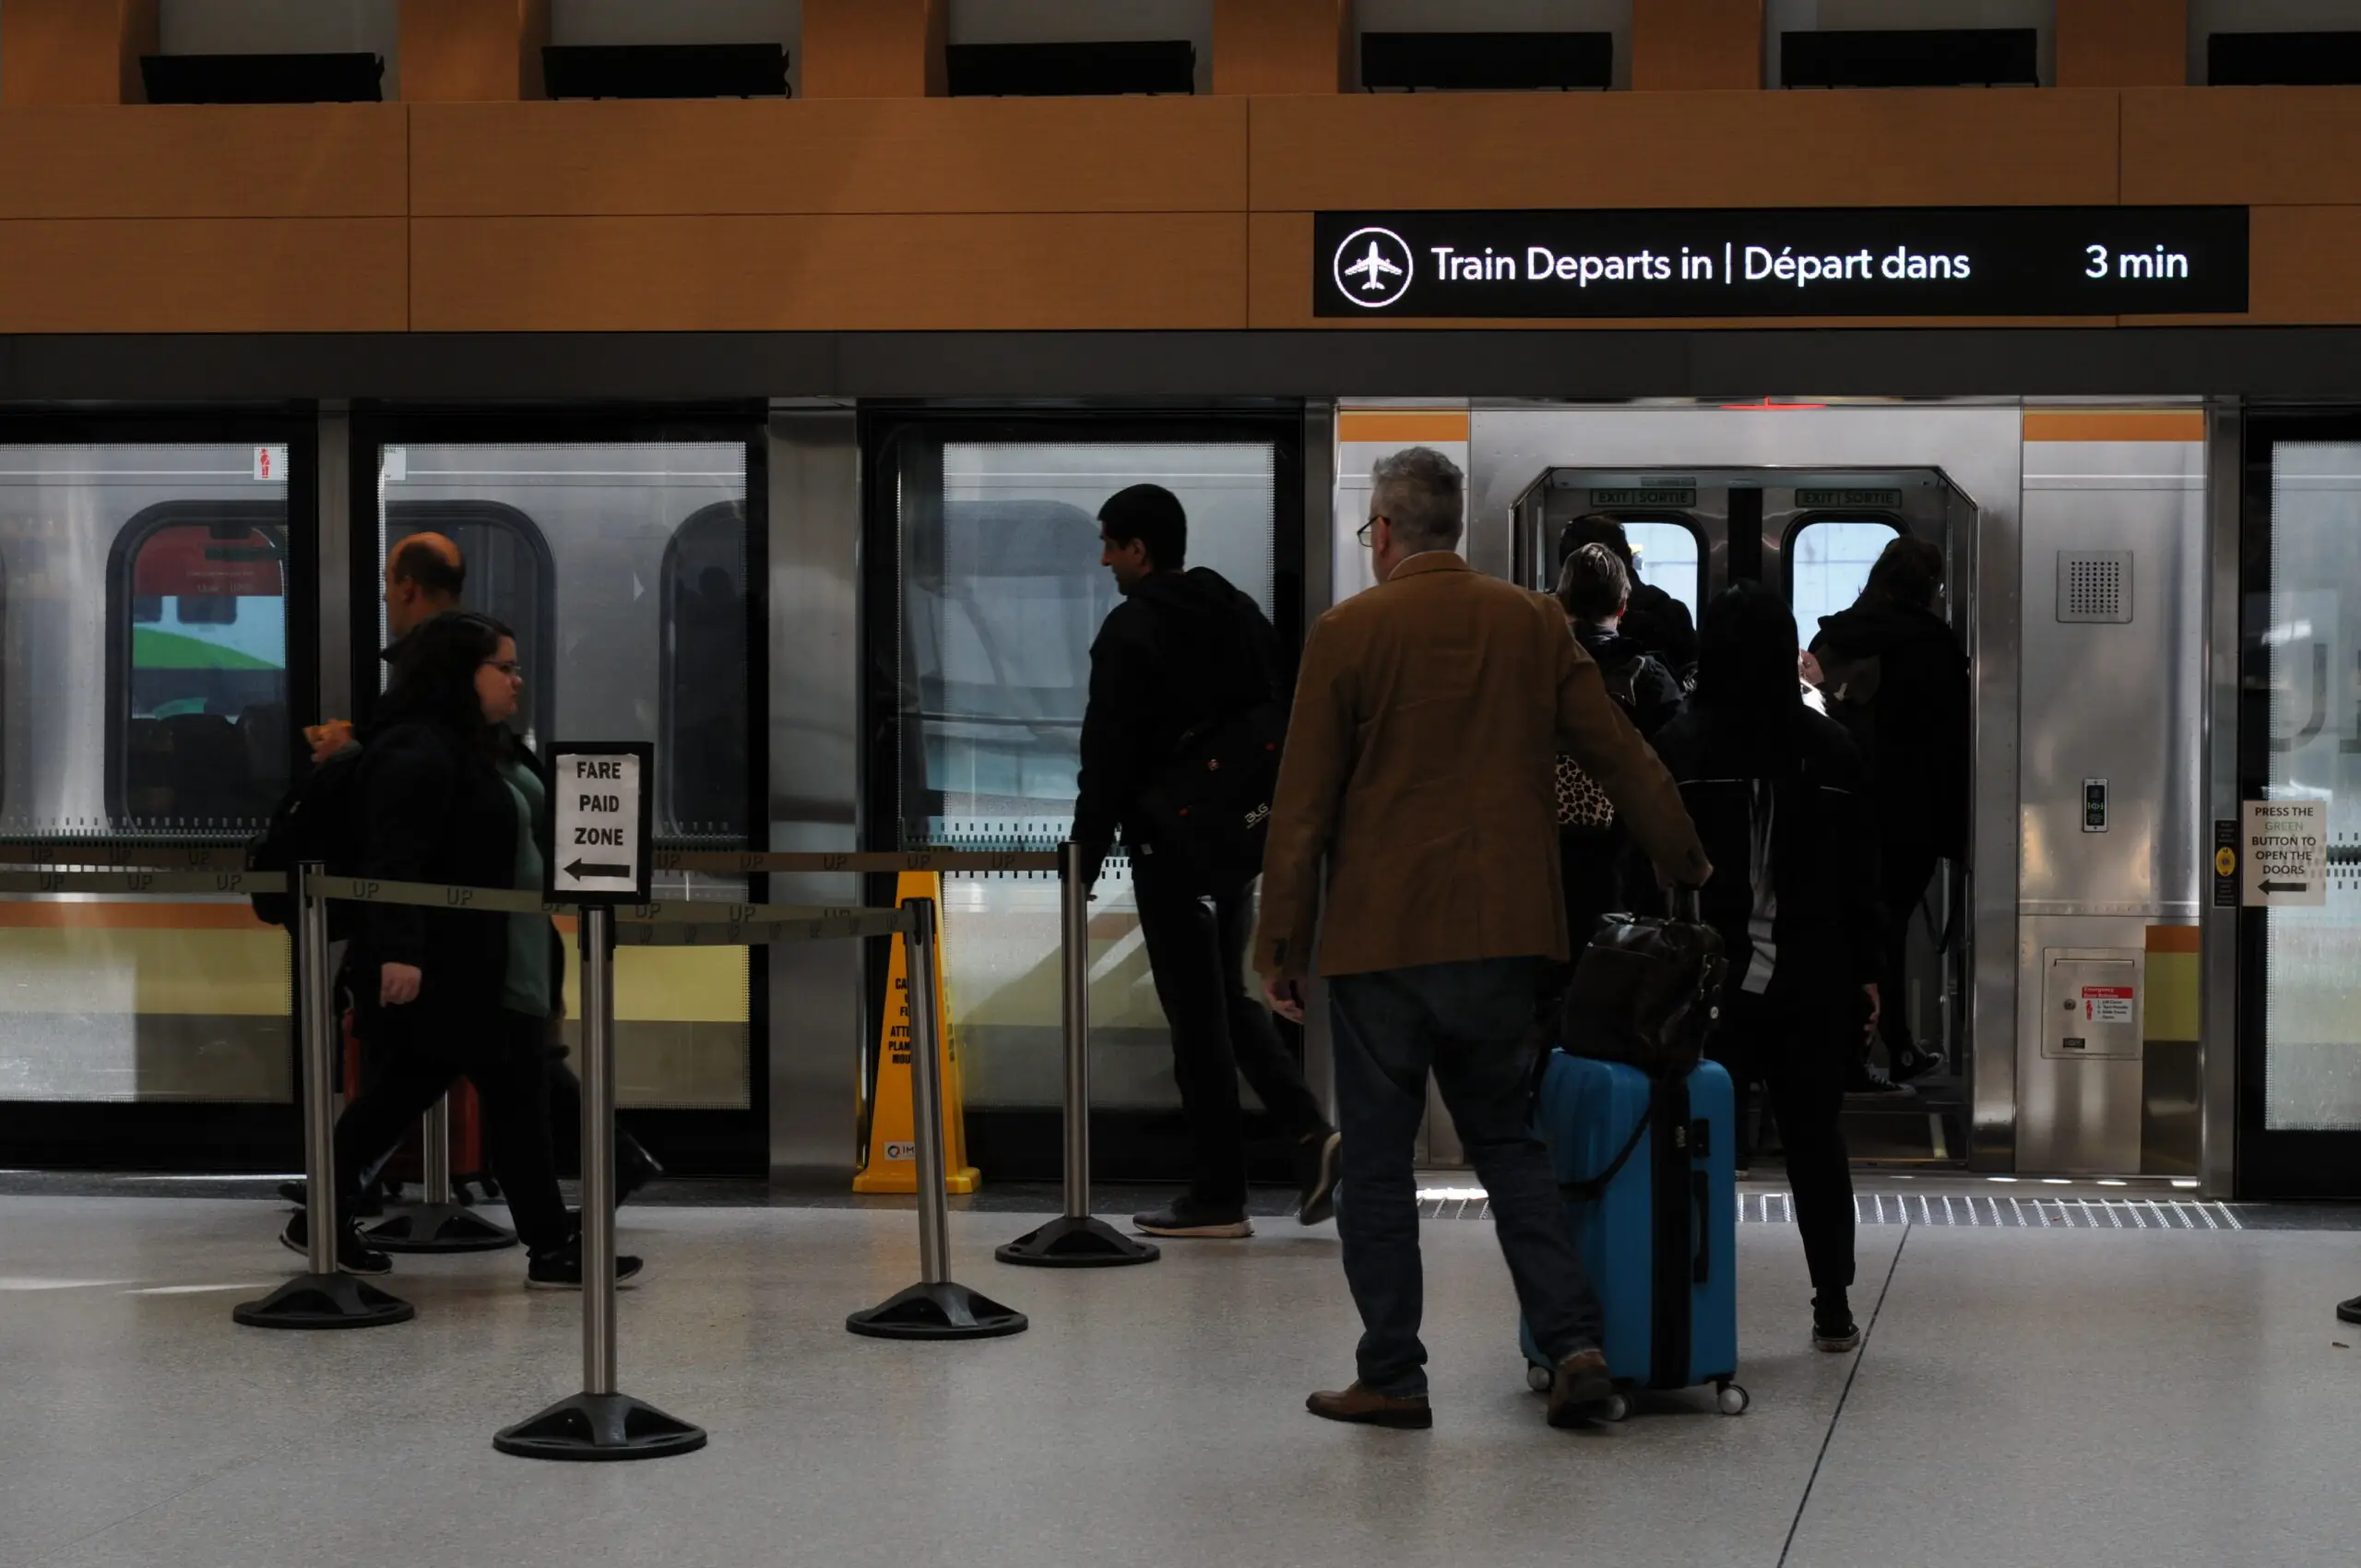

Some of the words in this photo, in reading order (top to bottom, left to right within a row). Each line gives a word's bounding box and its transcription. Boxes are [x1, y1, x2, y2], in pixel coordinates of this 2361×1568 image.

[1430, 246, 1515, 279] Train
[1527, 246, 1671, 288] Departs
[1681, 246, 1713, 279] in
[1745, 245, 1872, 287] Départ
[1881, 245, 1970, 279] dans
[2084, 244, 2107, 278] 3
[2119, 244, 2188, 278] min
[1599, 493, 1628, 503] EXIT
[1640, 493, 1688, 504] SORTIE
[1804, 493, 1833, 504] EXIT
[1845, 493, 1893, 504] SORTIE
[577, 761, 621, 779] FARE
[579, 794, 619, 813] PAID
[2255, 807, 2289, 816] PRESS
[2293, 807, 2314, 816] THE
[2264, 821, 2304, 831] GREEN
[574, 827, 623, 846] ZONE
[2251, 837, 2298, 846] BUTTON
[2302, 837, 2317, 846] TO
[824, 854, 848, 871] UP
[908, 854, 931, 870] UP
[2255, 851, 2288, 861] OPEN
[2292, 851, 2312, 861] THE
[2262, 865, 2306, 874] DOORS
[39, 873, 65, 891] UP
[127, 873, 153, 891] UP
[217, 874, 243, 892] UP
[353, 880, 379, 899] UP
[446, 887, 473, 906] UP
[635, 903, 661, 920] UP
[730, 905, 756, 922] UP
